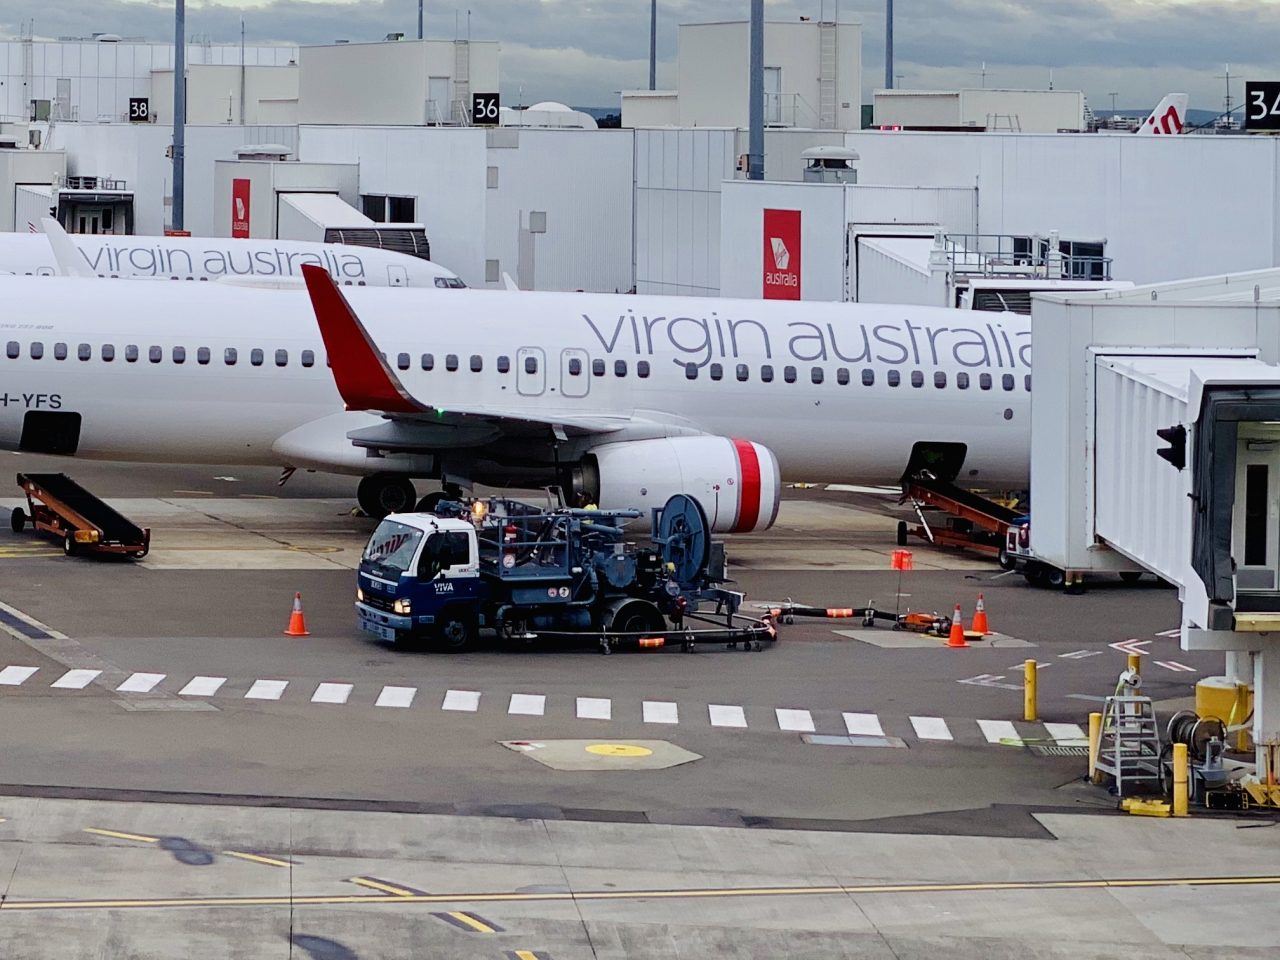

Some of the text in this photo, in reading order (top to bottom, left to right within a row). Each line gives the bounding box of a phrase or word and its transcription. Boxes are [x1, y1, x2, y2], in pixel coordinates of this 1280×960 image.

[131, 102, 147, 116] 38
[475, 99, 498, 118] 36
[78, 242, 194, 276] virgin
[766, 272, 798, 287] australia
[582, 309, 772, 369] virgin
[434, 583, 454, 591] VIVA
